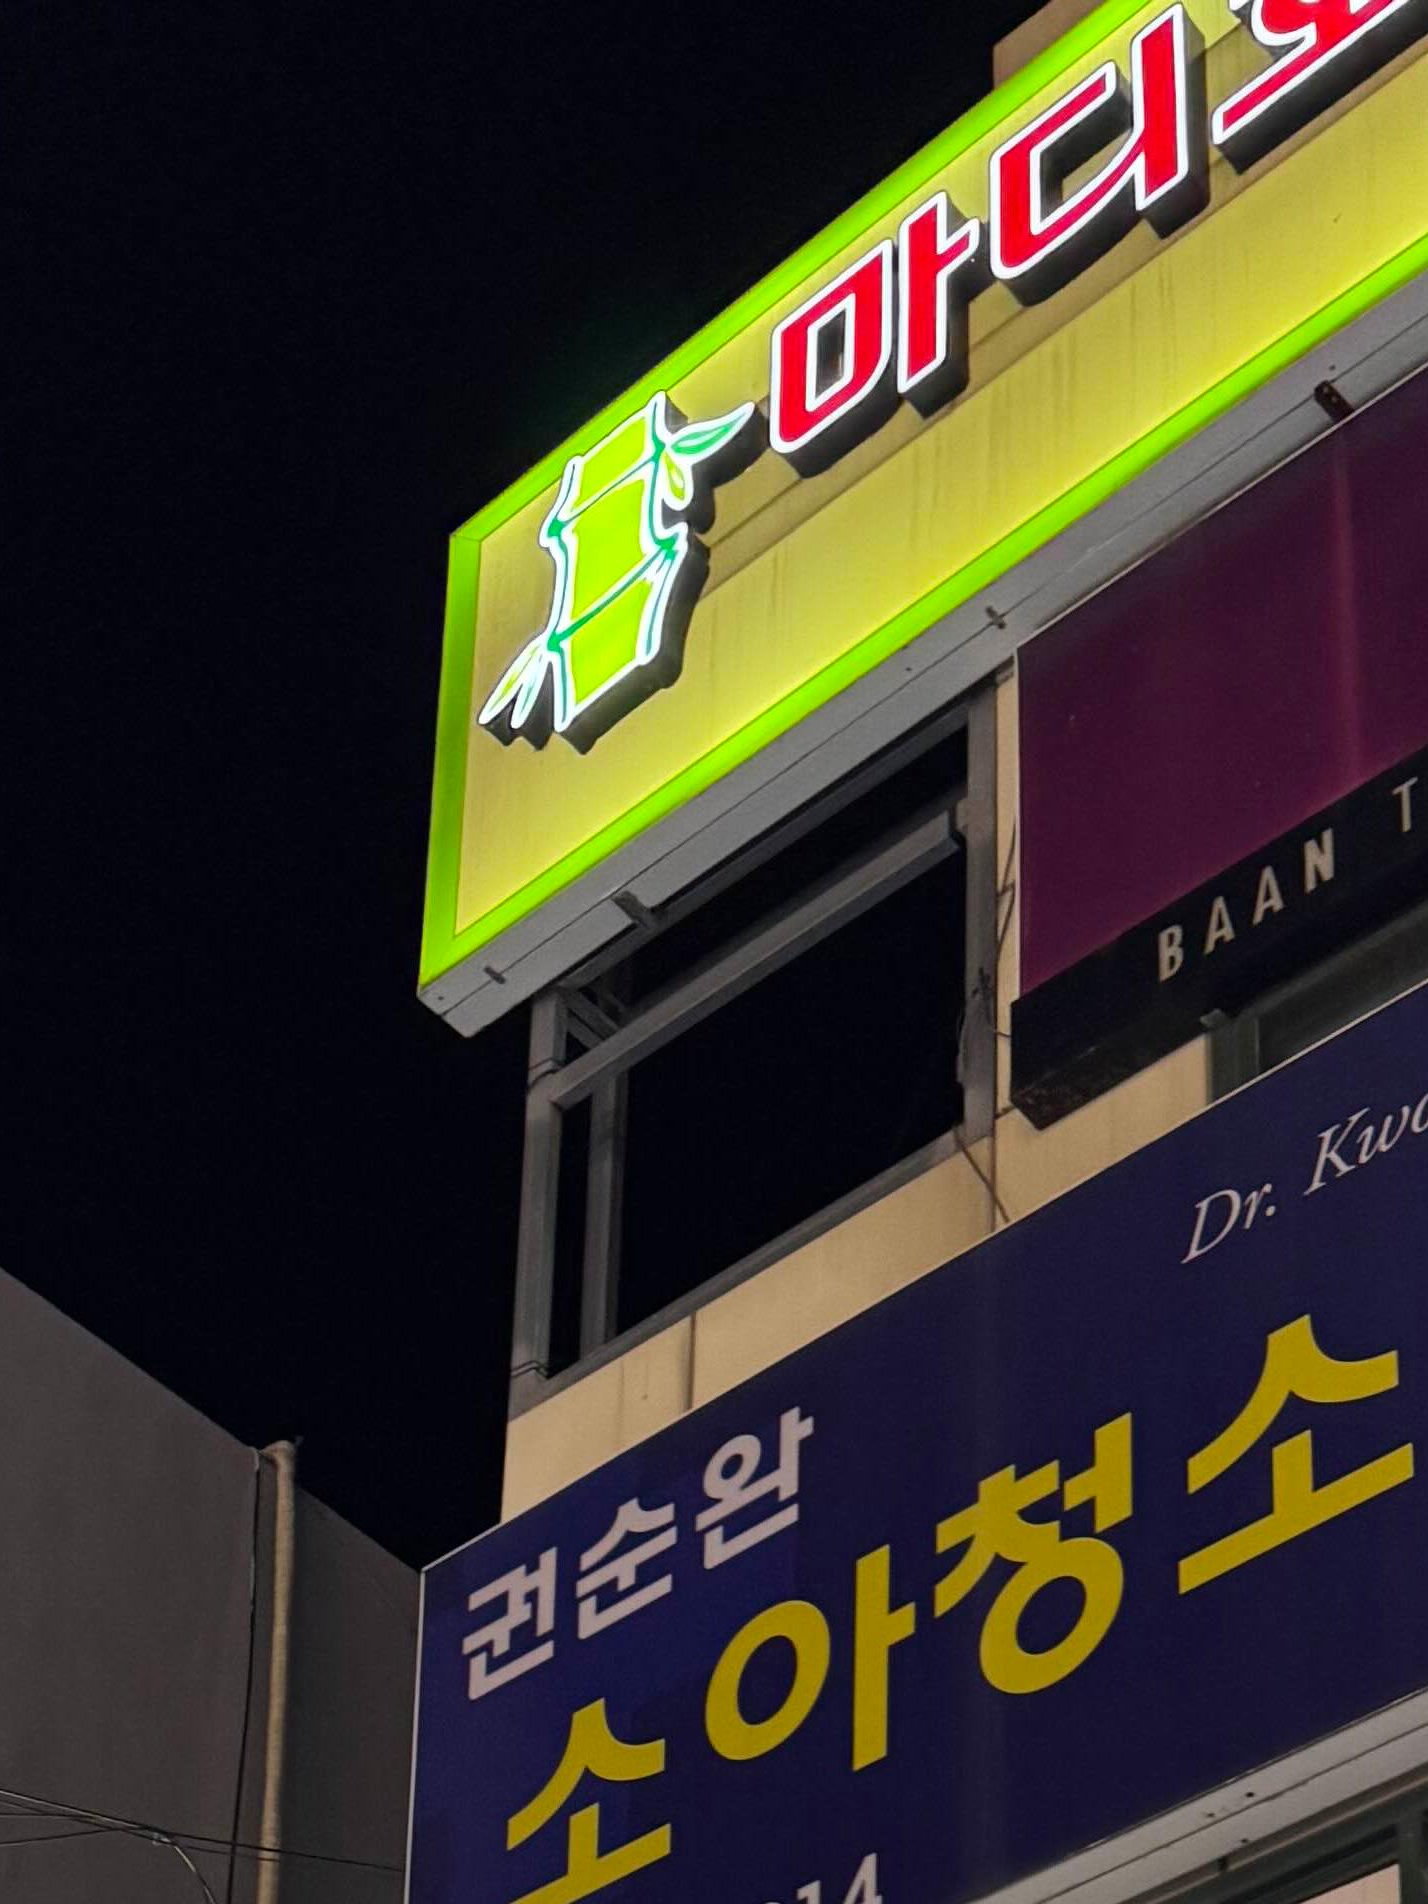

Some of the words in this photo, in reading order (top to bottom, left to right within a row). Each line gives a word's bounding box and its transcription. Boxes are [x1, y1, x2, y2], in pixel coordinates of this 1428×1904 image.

[1156, 835, 1337, 984] BAAN
[1181, 1180, 1280, 1264] Dr.
[461, 1405, 814, 1701] 권순완
